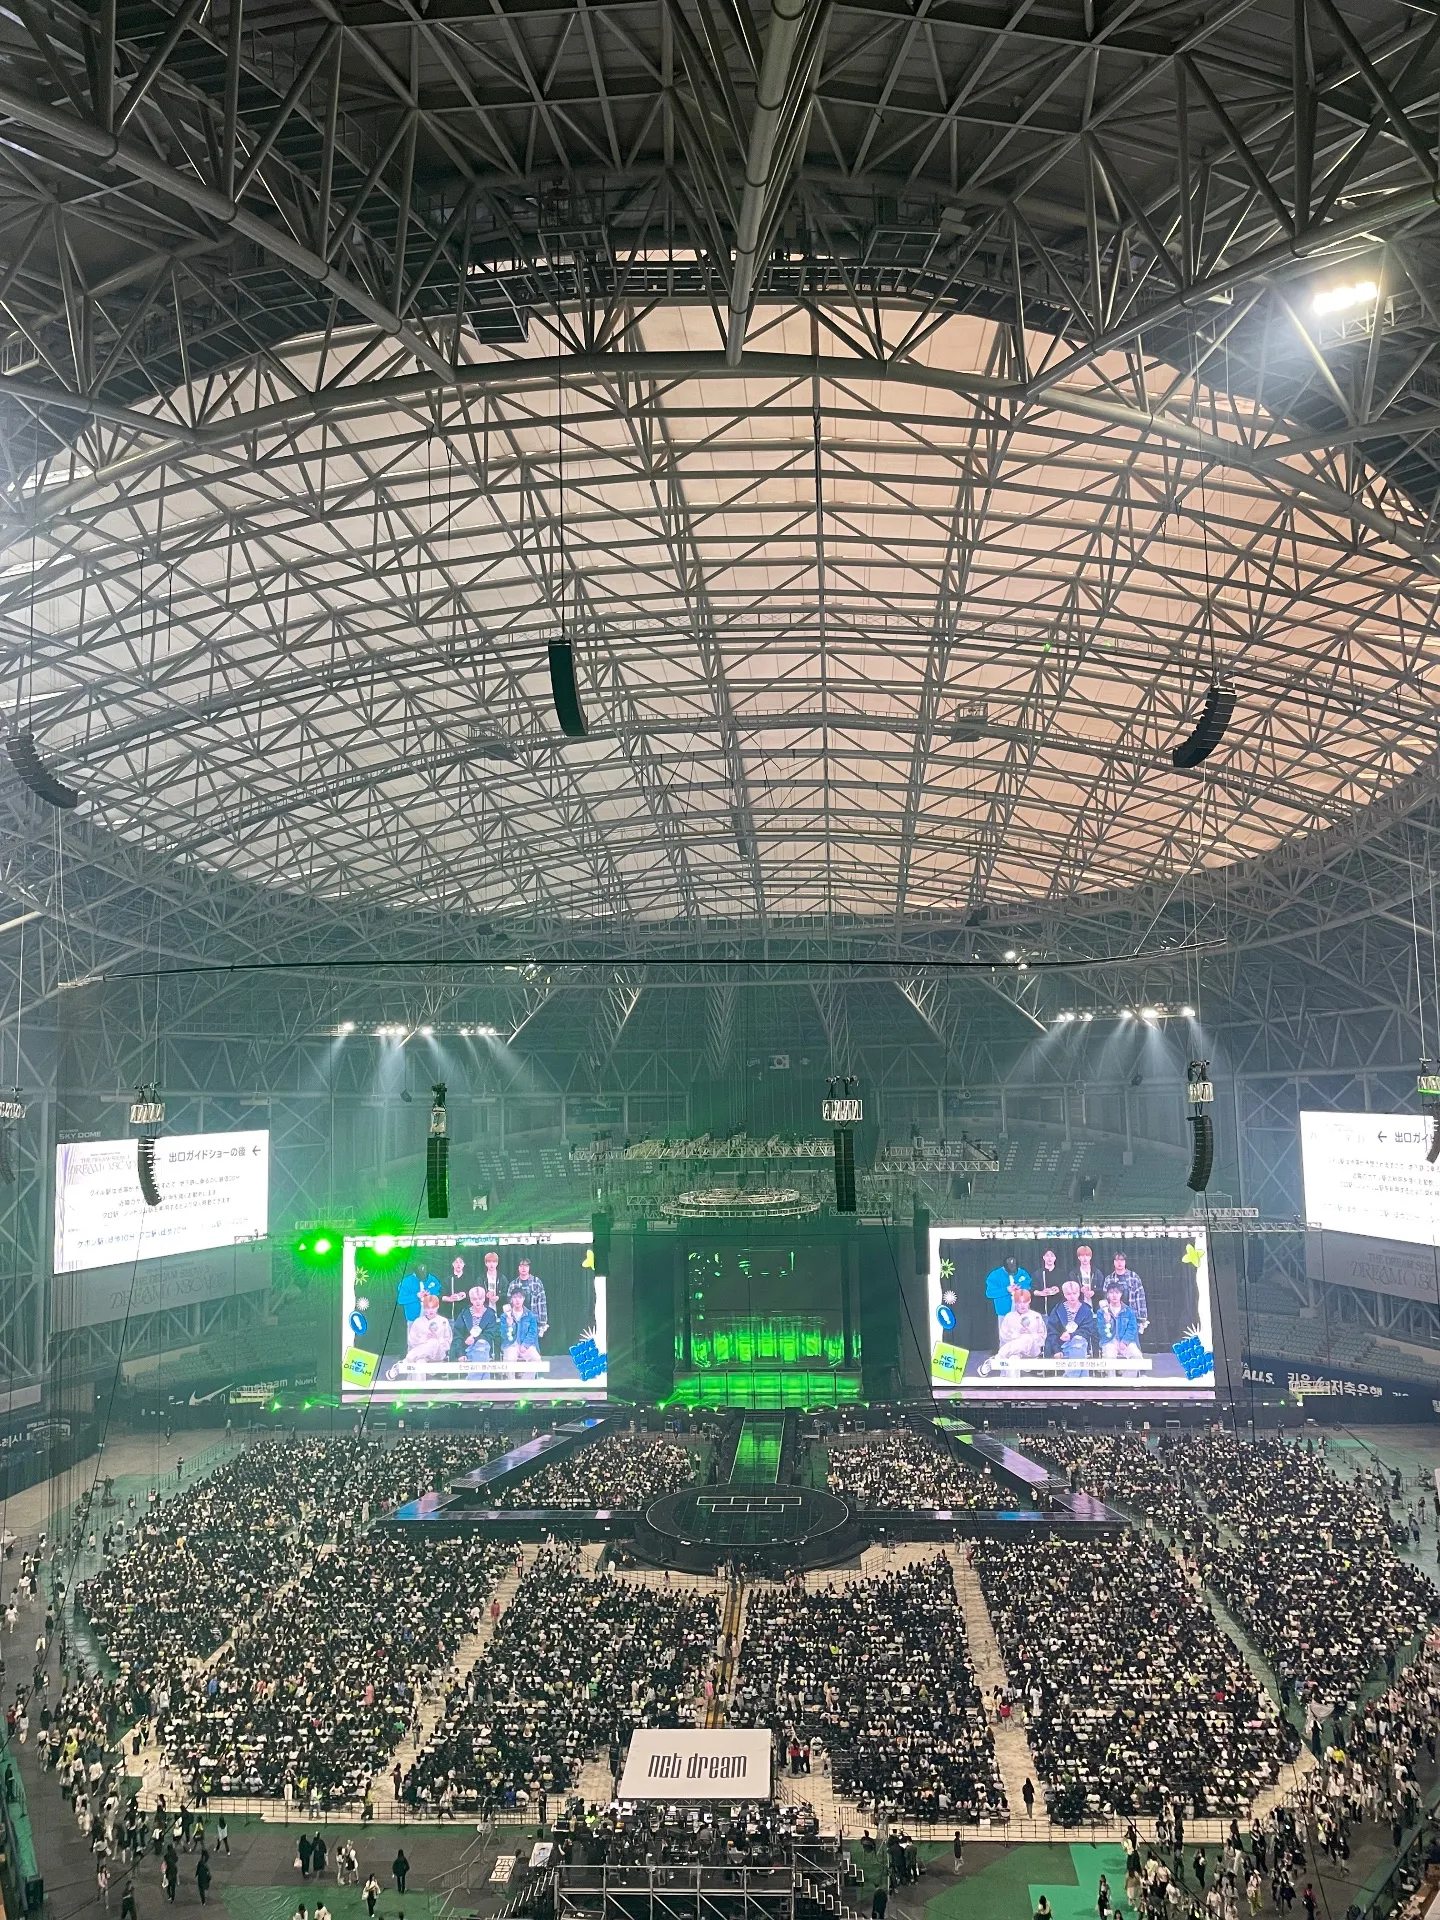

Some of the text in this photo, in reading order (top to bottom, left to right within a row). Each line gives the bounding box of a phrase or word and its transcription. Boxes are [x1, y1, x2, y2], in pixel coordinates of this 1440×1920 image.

[352, 1360, 368, 1368] NCT
[941, 1355, 958, 1364] NCT
[933, 1359, 962, 1372] DREAM
[648, 1753, 747, 1779] nct dream
